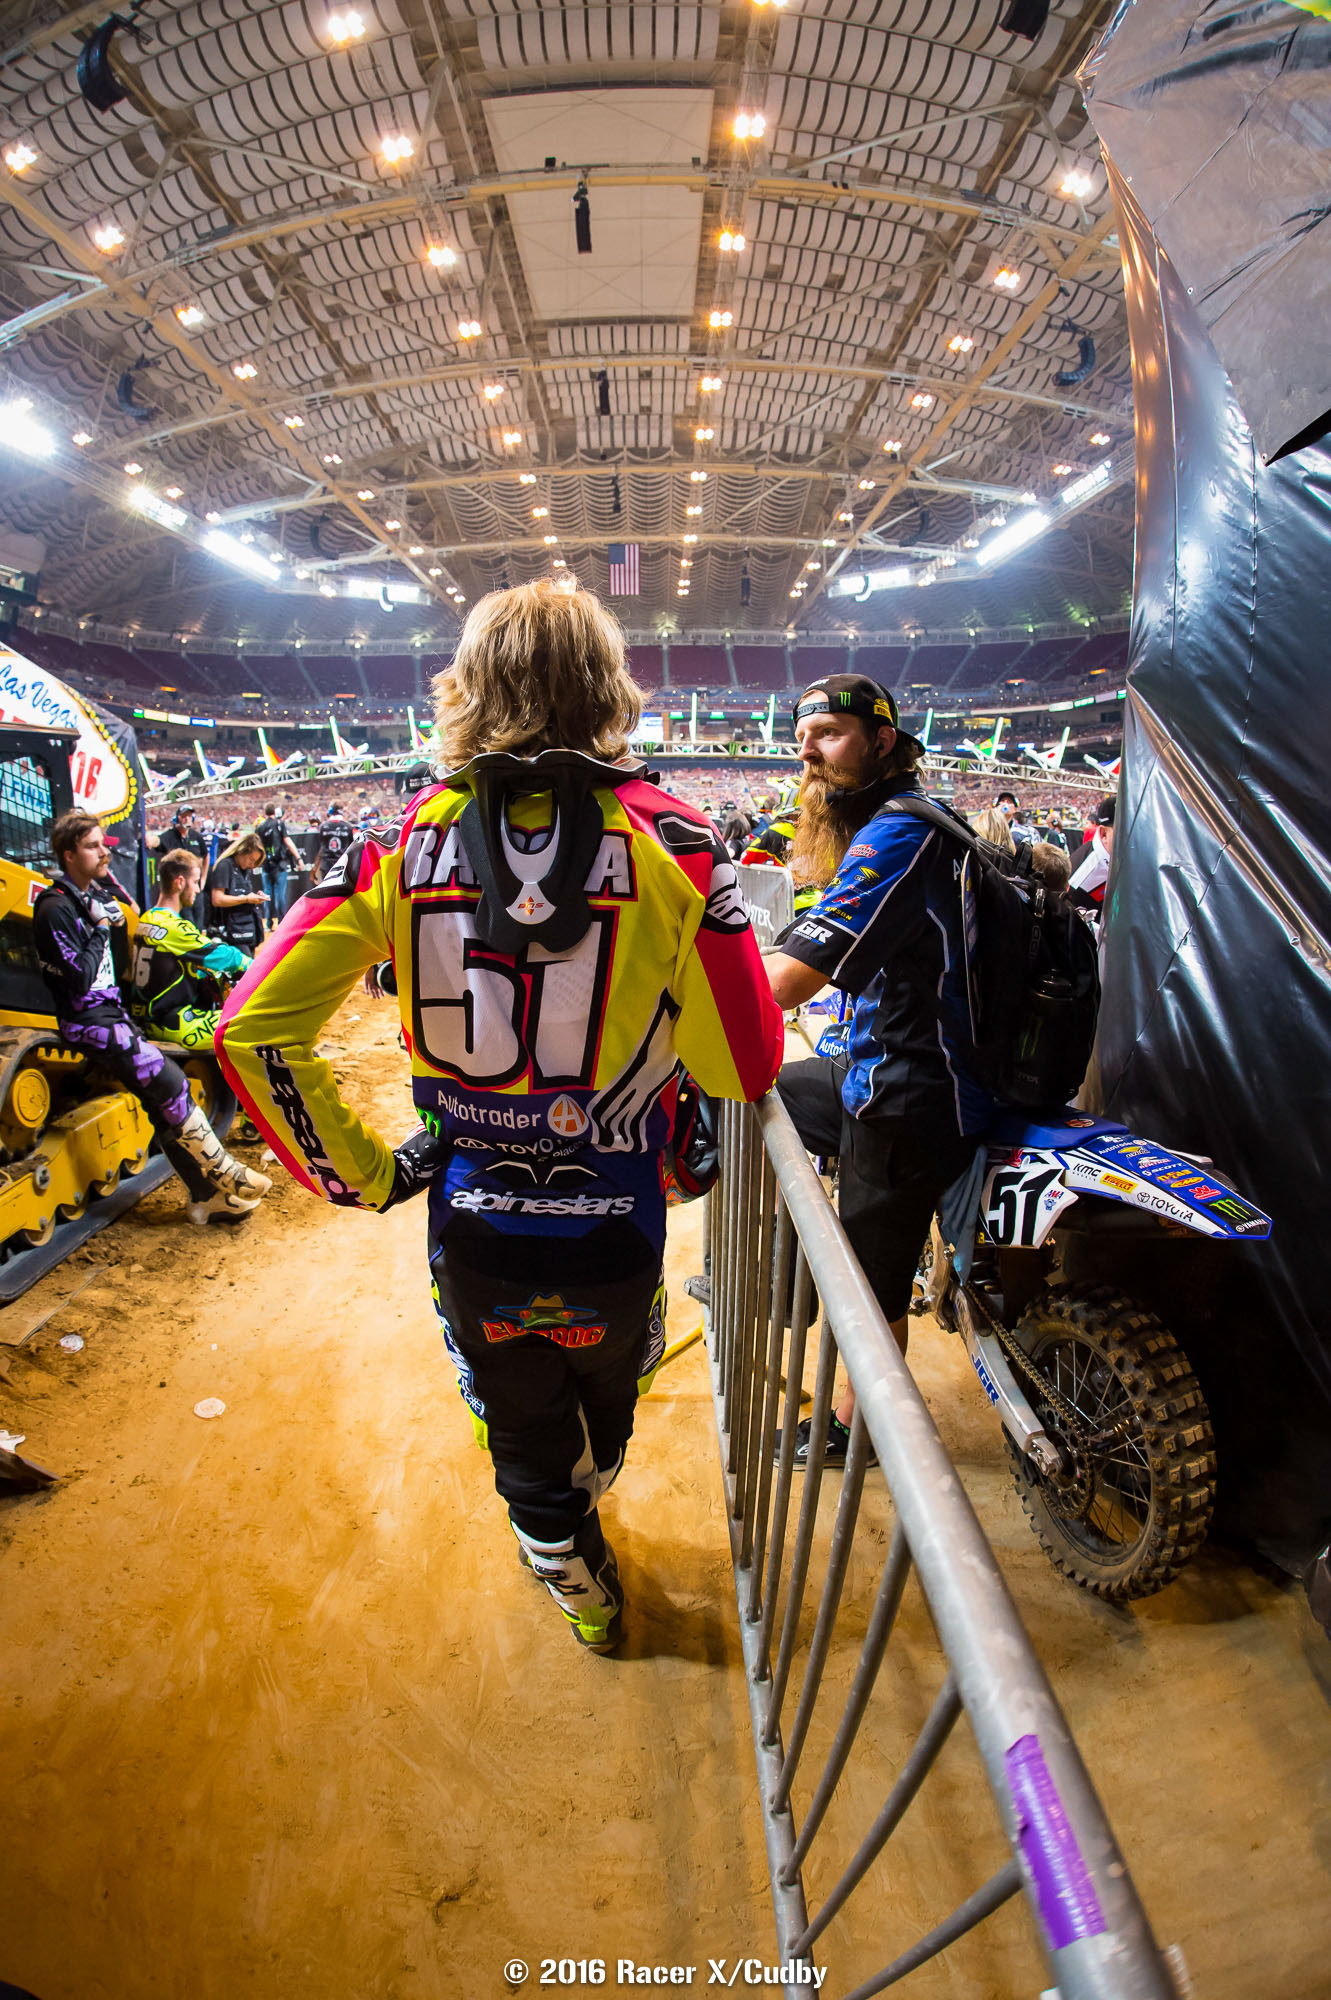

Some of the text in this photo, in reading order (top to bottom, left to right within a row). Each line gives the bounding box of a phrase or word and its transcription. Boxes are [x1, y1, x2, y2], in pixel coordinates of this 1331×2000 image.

[31, 681, 78, 728] Vegas
[402, 821, 638, 898] BAA
[412, 905, 620, 1092] 51
[438, 1090, 541, 1130] Autotrader
[496, 1138, 568, 1155] TOYO
[1073, 1163, 1101, 1177] KMC
[1104, 1175, 1134, 1191] PIRELLI
[450, 1188, 635, 1215] alpinestars
[988, 1168, 1063, 1246] 51
[1044, 1190, 1064, 1199] AMA
[971, 1352, 1000, 1407] JGR
